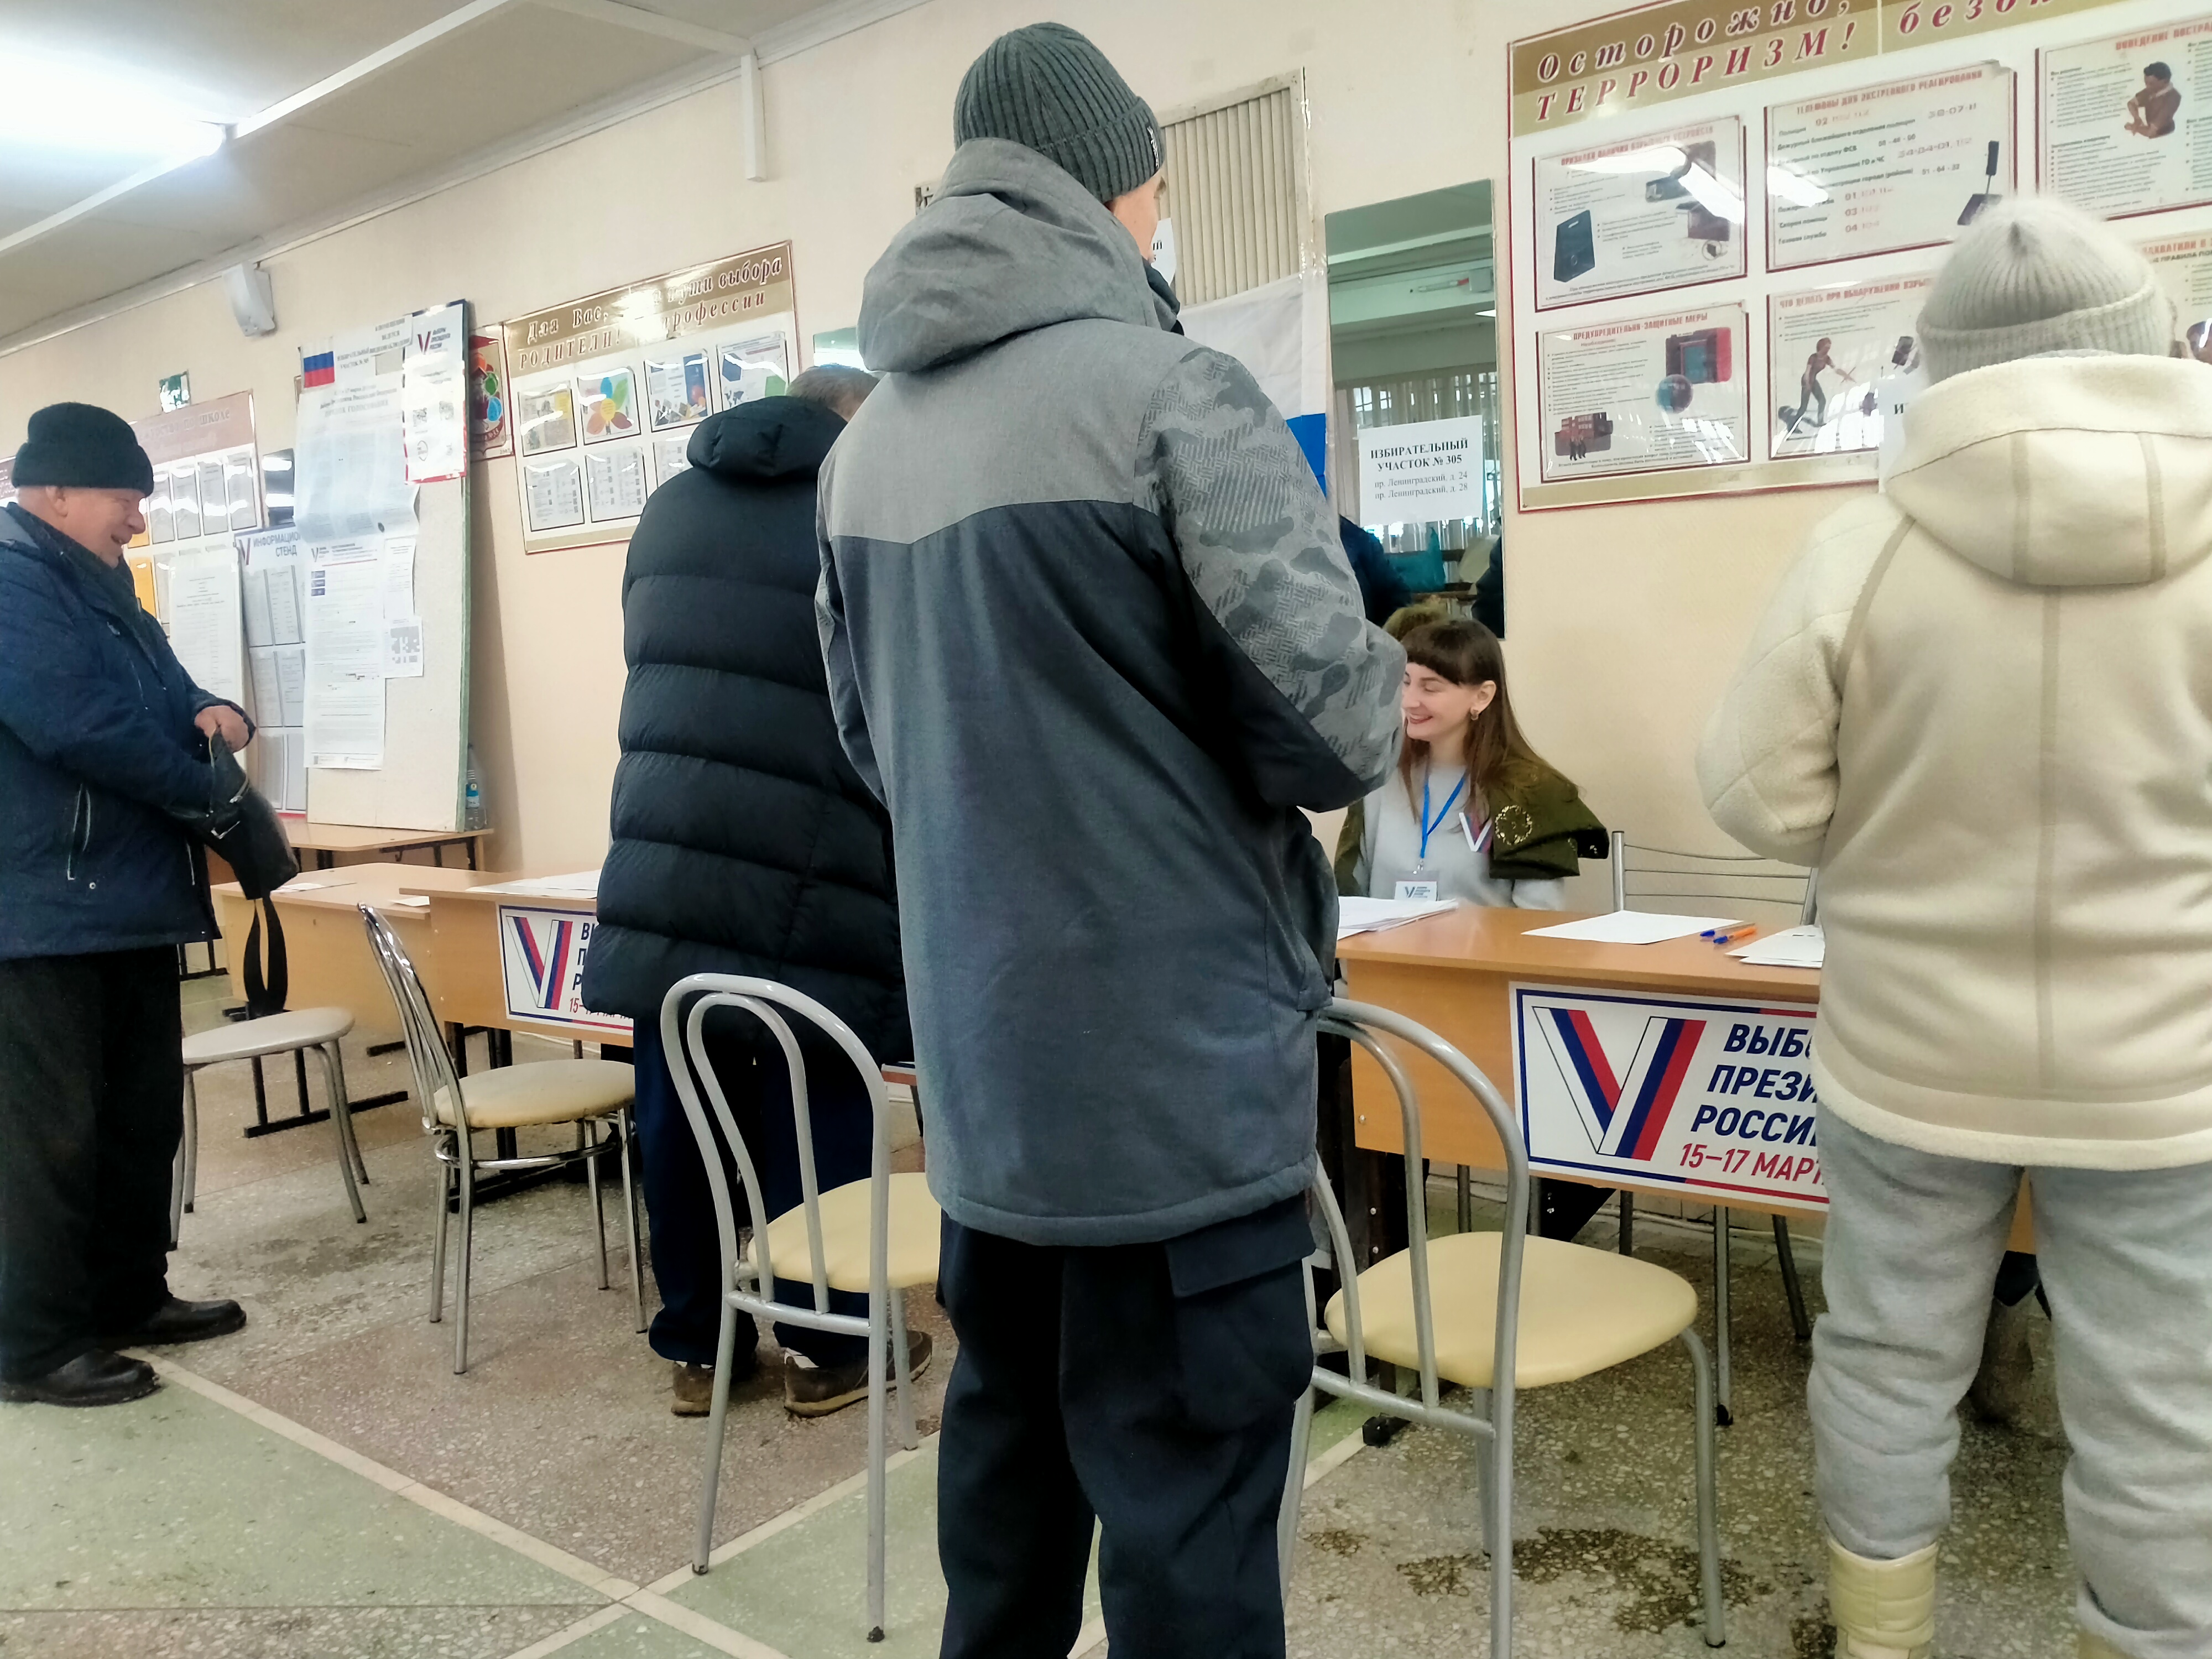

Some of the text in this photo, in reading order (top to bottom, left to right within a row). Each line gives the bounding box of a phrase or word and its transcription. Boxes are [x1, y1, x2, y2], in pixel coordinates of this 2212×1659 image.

[1899, 0, 2051, 35] безо
[1538, 0, 1849, 81] Осторожно,
[2173, 20, 2212, 39] ПОСТРА
[1537, 22, 1856, 121] ТЕРРОРИЗМ!
[718, 256, 782, 288] выбора
[528, 306, 608, 345] Для Вас,
[1686, 312, 1708, 322] МЕРЫ
[520, 328, 620, 370] РОДИТЕЛИ!
[1371, 437, 1468, 459] ИЗБИРАТЕЛЬНЫЙ
[1377, 455, 1462, 472] УЧАСТОК № 305
[1375, 479, 1386, 489] пр.
[1387, 473, 1449, 487] Ленинградский,
[1458, 471, 1468, 479] 24
[1375, 492, 1386, 500] пр.
[1387, 486, 1449, 499] Ленинградский,
[1458, 483, 1468, 492] 28
[276, 545, 298, 557] СТЕНД
[581, 922, 595, 940] В
[1723, 1023, 1813, 1060] ВЫБ
